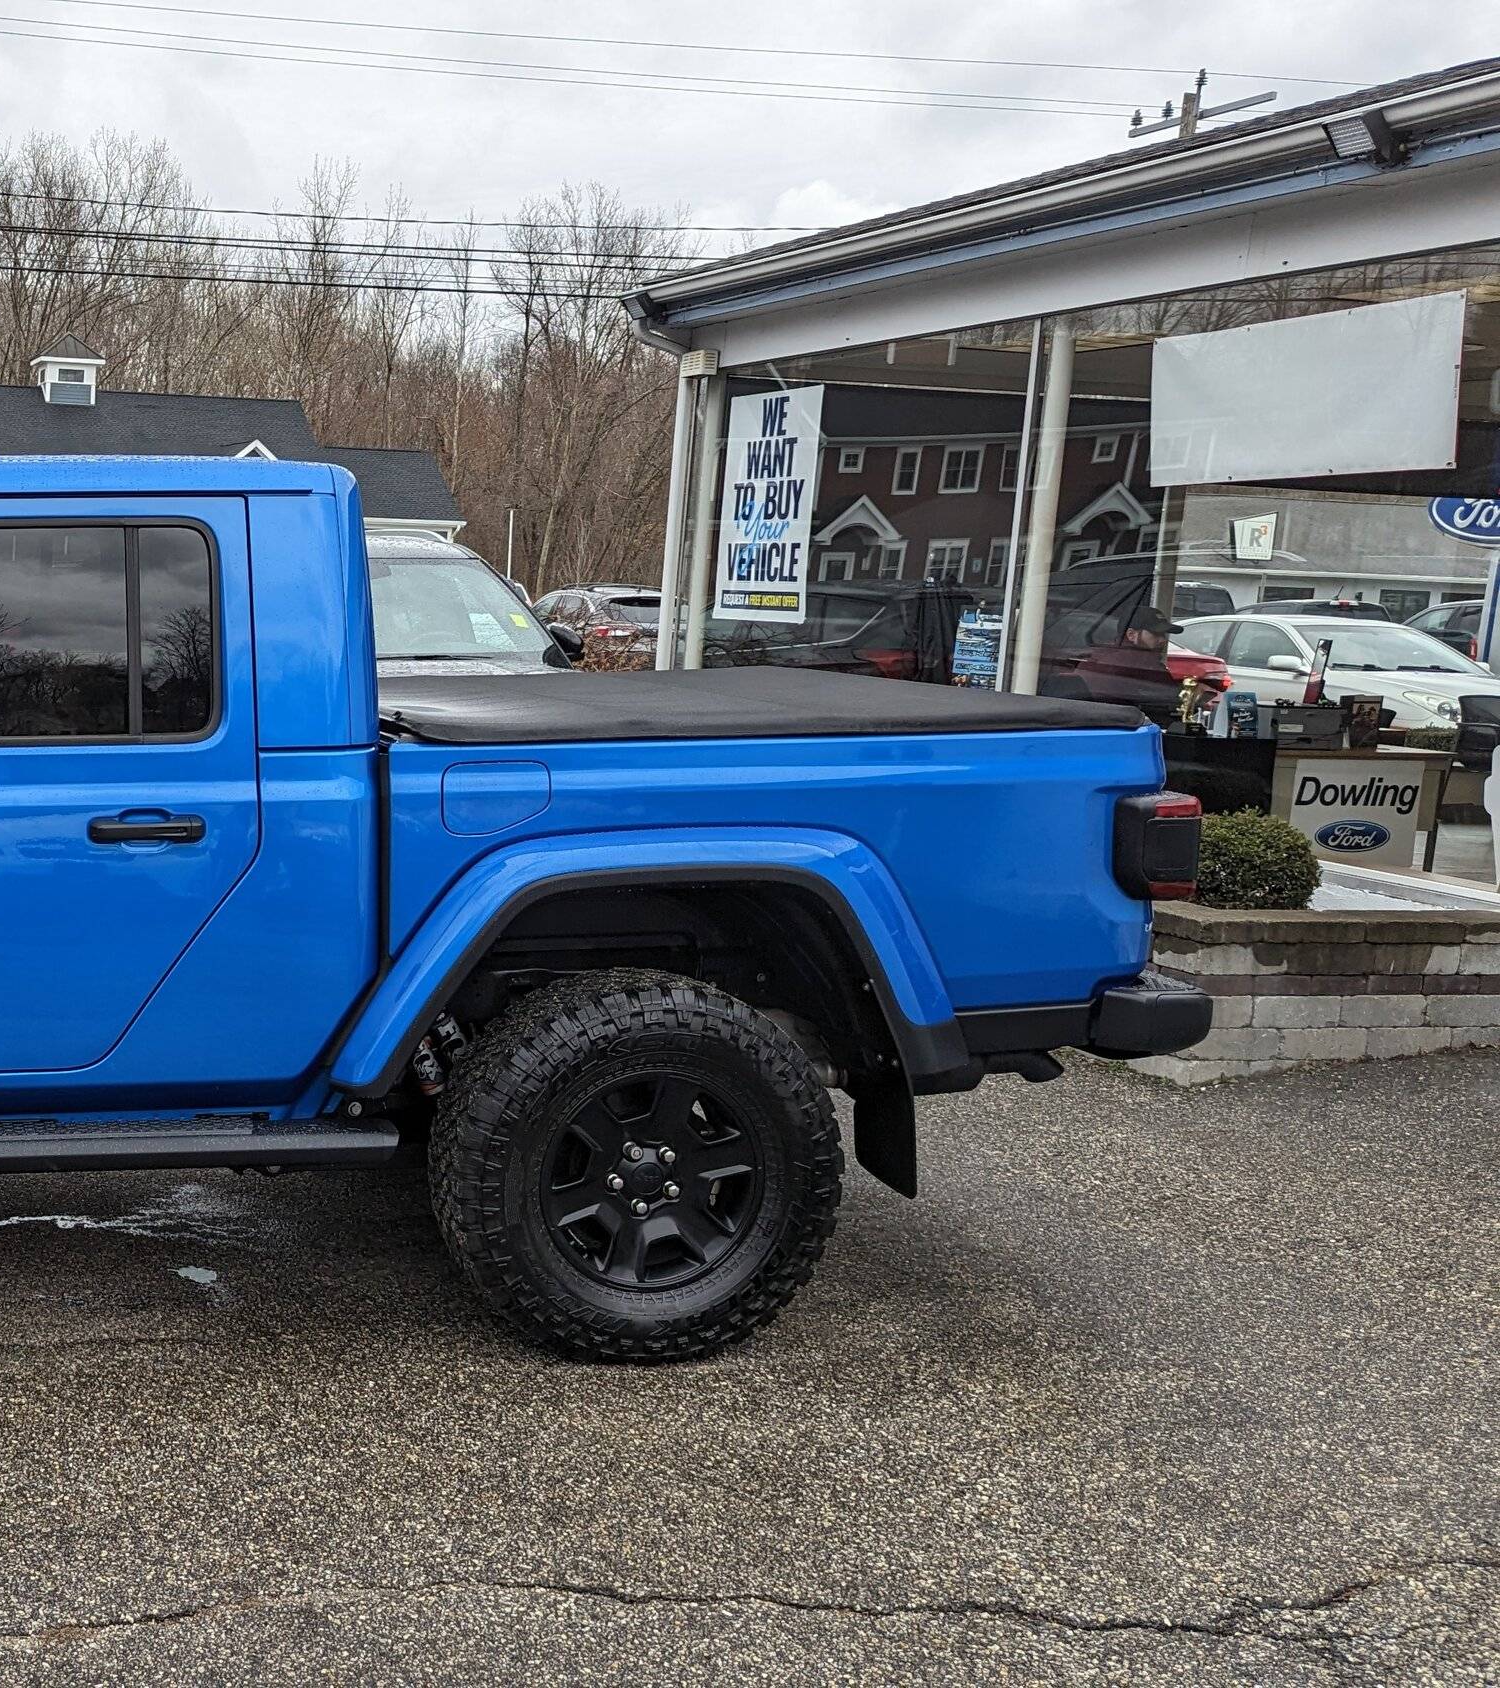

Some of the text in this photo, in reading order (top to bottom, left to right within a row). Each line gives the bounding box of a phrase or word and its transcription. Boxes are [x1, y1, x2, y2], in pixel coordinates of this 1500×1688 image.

[762, 396, 790, 437] WE
[747, 437, 798, 479] WANT
[734, 479, 805, 521] TO BUY
[737, 500, 790, 576] Your
[728, 542, 801, 582] VEHICLE
[1294, 776, 1419, 815] Dowling
[1328, 824, 1378, 847] Ford
